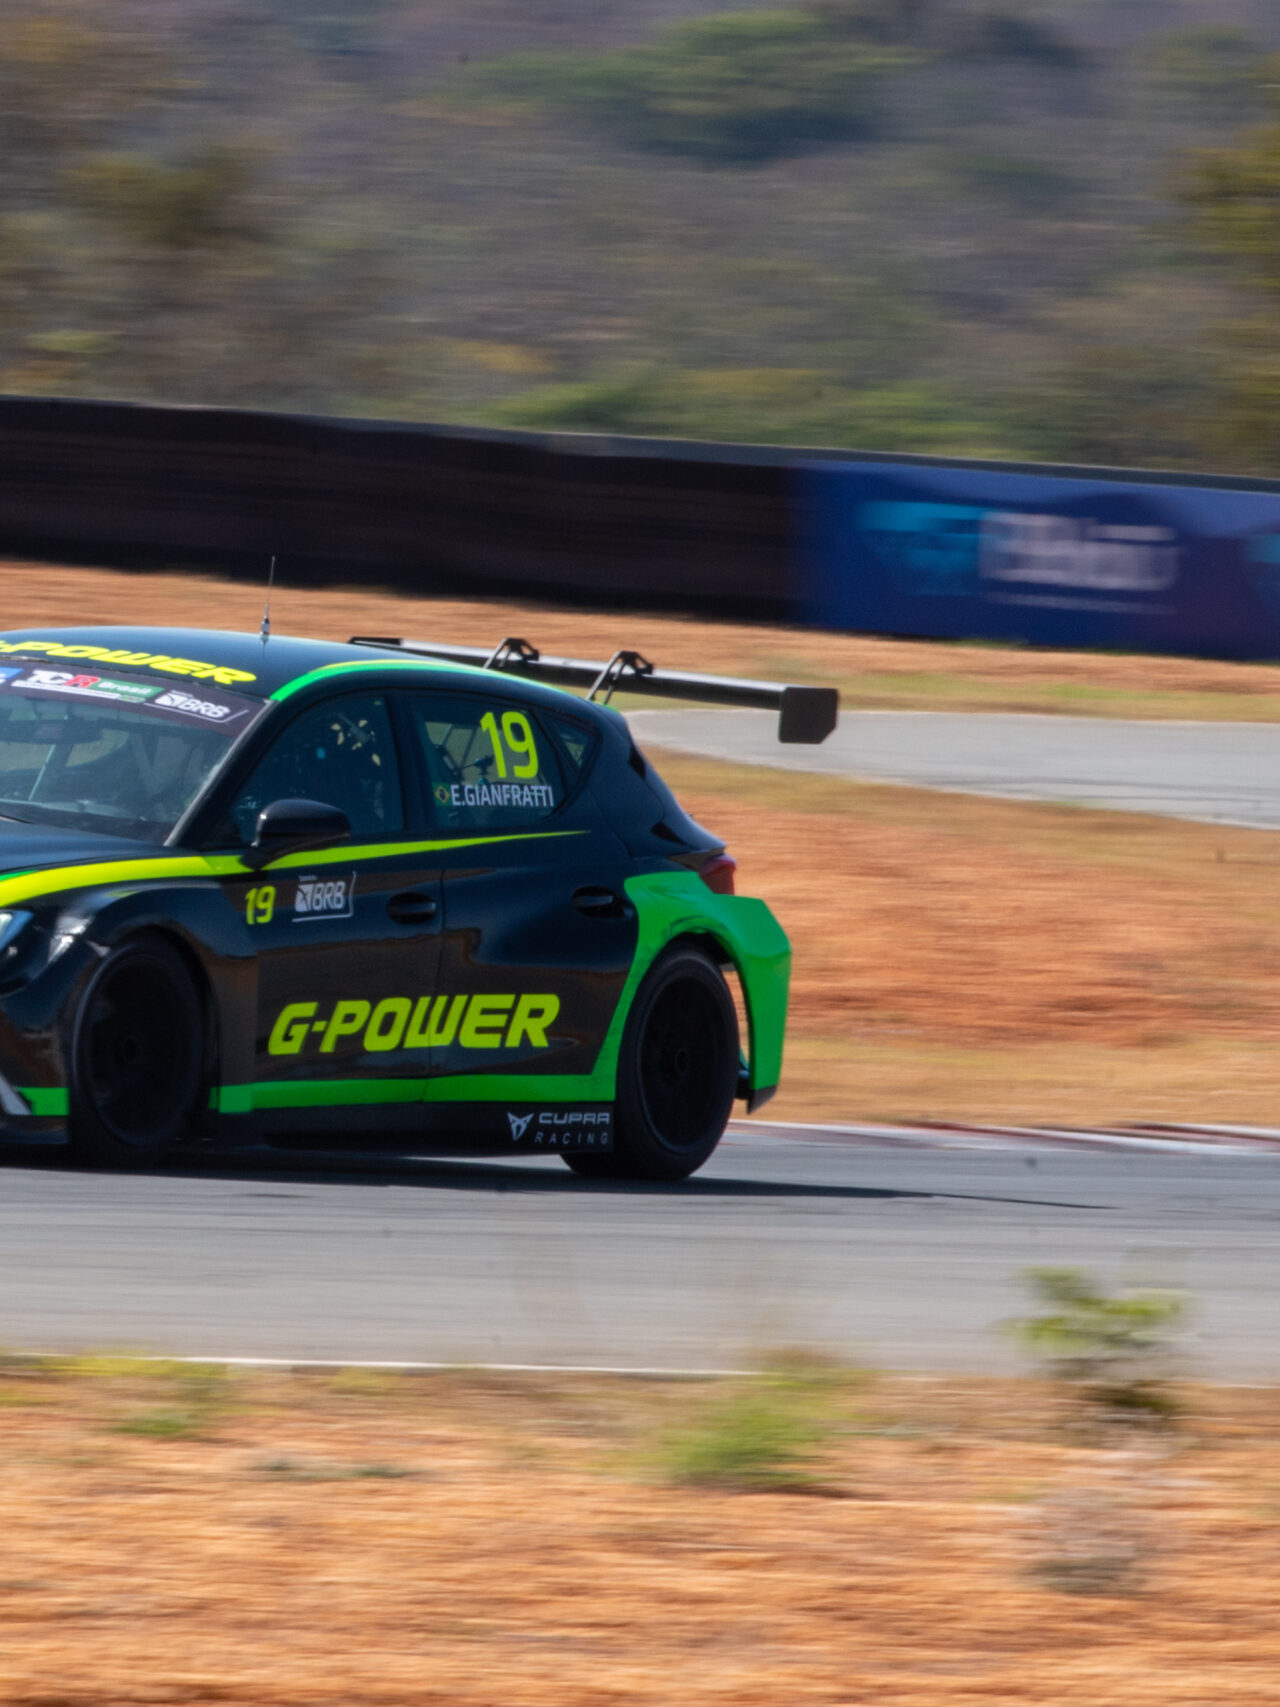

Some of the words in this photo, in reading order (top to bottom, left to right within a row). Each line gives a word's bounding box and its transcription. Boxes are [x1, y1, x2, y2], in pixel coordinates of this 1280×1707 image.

[27, 669, 101, 688] TCR
[178, 698, 231, 718] BRB
[480, 711, 539, 778] 19
[450, 784, 554, 807] E.GIANFRATTI
[245, 885, 276, 925] 19
[312, 881, 346, 911] BRB
[268, 993, 560, 1056] G-POWER
[538, 1112, 610, 1125] CUPRA
[535, 1132, 609, 1145] RACING
